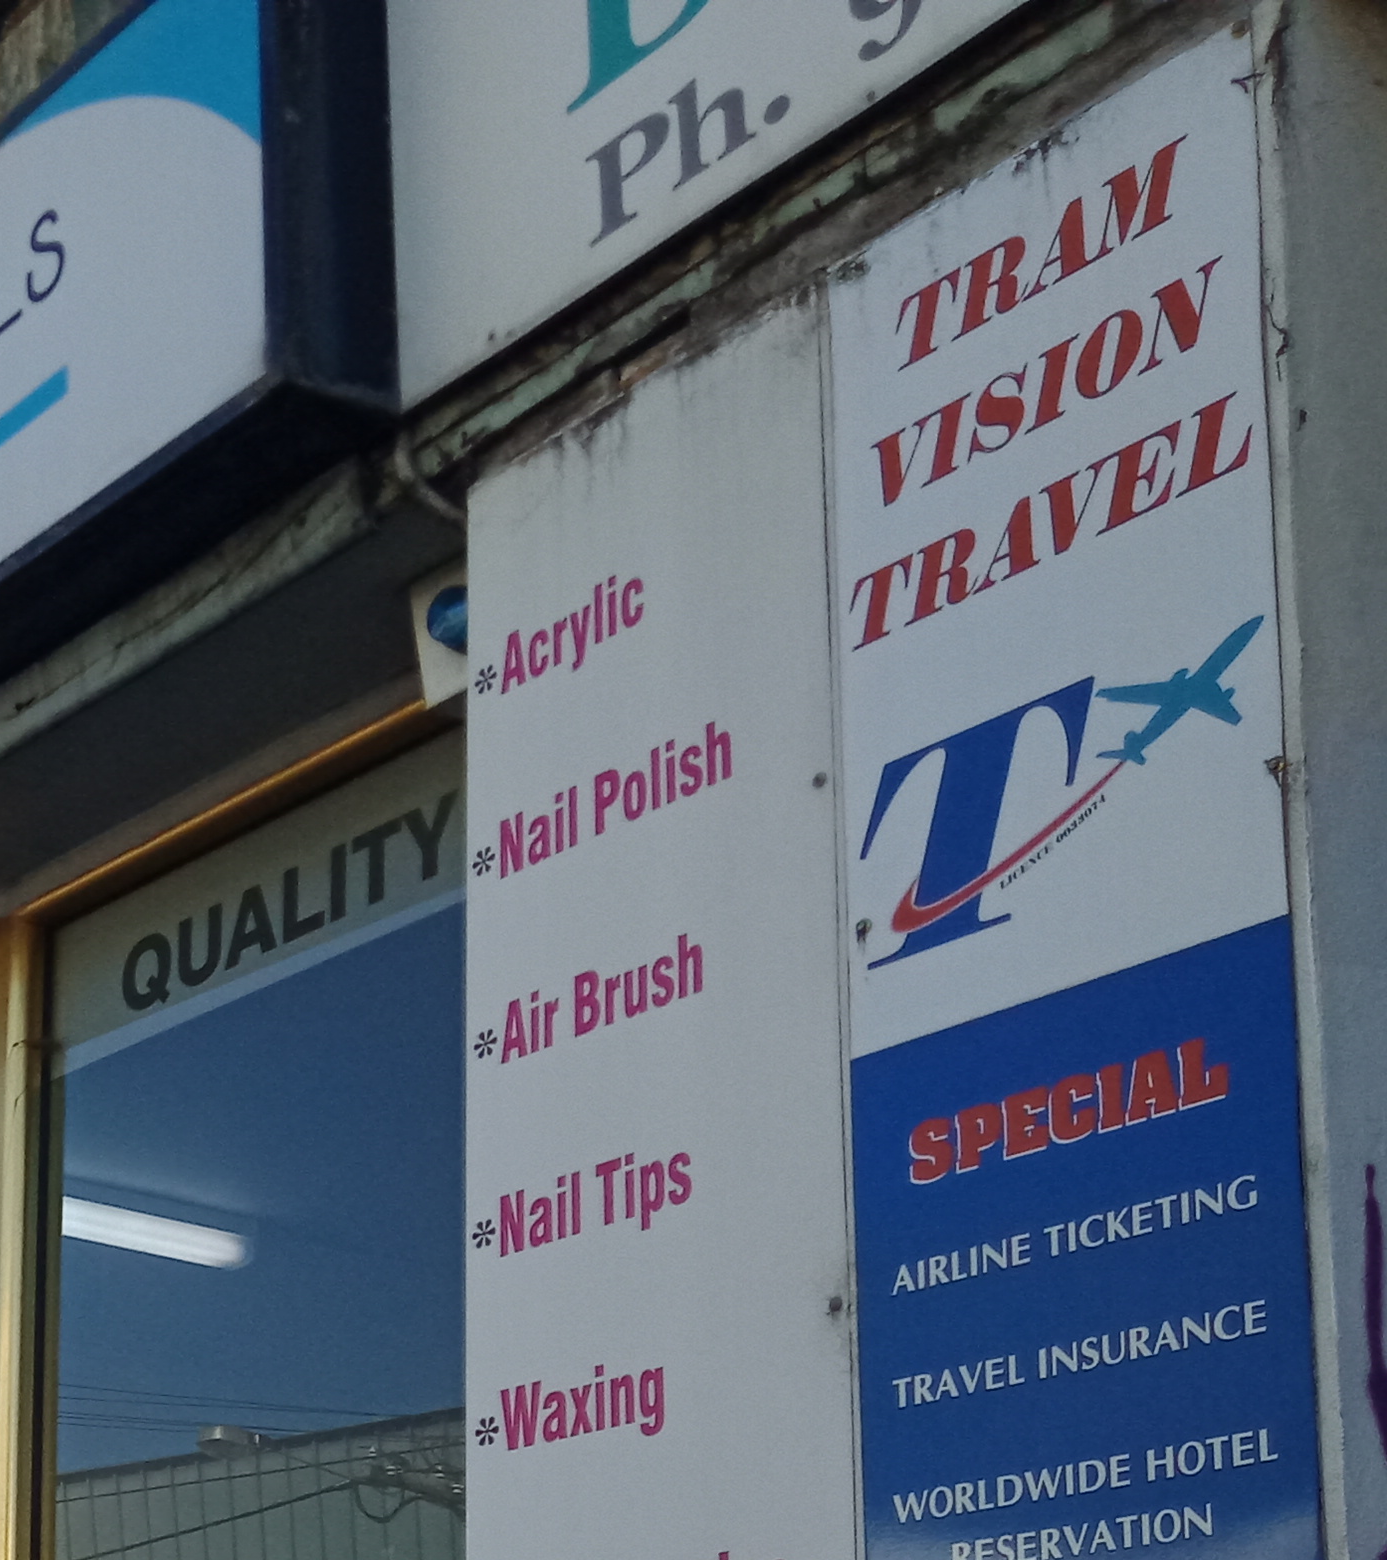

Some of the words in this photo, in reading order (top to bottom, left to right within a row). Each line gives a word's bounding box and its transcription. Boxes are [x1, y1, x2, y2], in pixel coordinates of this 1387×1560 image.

[585, 77, 791, 247] Ph.
[894, 134, 1188, 371] TRAM
[870, 255, 1223, 507] VISION
[848, 392, 1255, 654] TRAVEL
[501, 576, 645, 694] Acrylic
[500, 784, 578, 880] Nail
[594, 721, 733, 836] Polish
[122, 788, 461, 1011] QUALITY
[501, 990, 559, 1064] Air
[575, 933, 704, 1038] Brush
[908, 1037, 1230, 1186] SPECIAL
[500, 1171, 581, 1257] Nail
[596, 1152, 692, 1230] Tips
[890, 1233, 1032, 1297] AIRLINE
[1043, 1174, 1259, 1258] TICKETING
[501, 1364, 665, 1451] Waxing
[892, 1353, 1025, 1410] TRAVEL
[1038, 1299, 1268, 1381] INSURANCE
[893, 1453, 1131, 1524] WORLDWIDE
[1146, 1428, 1279, 1483] HOTEL
